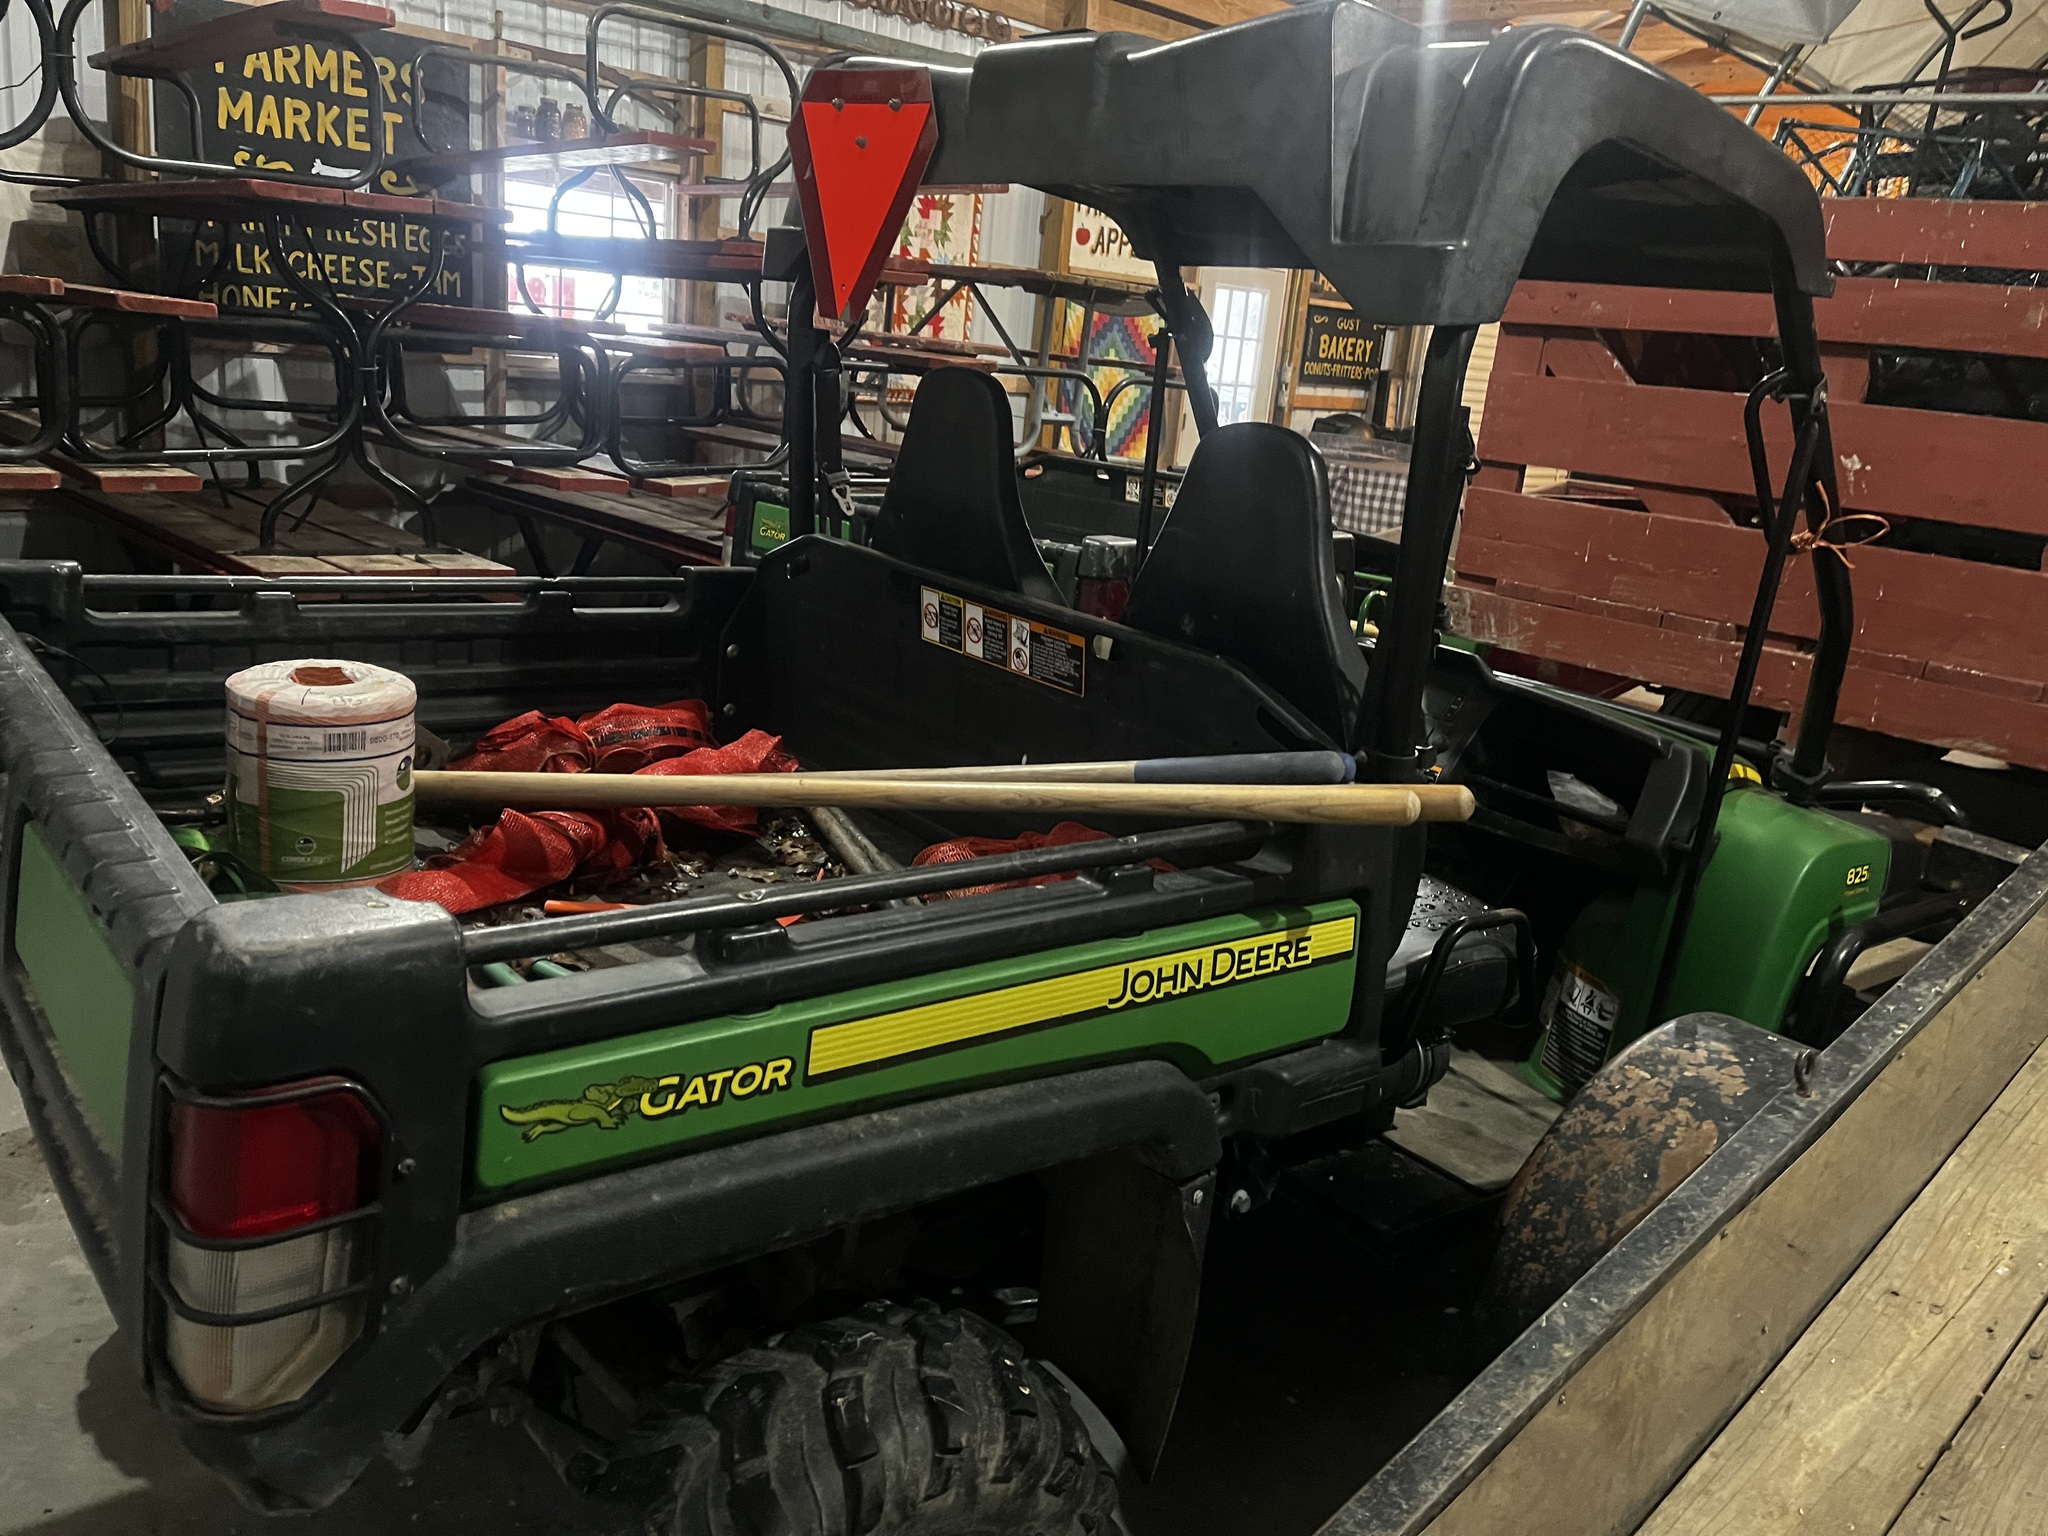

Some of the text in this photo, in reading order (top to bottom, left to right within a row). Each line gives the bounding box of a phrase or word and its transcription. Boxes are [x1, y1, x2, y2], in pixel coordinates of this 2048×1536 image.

[214, 44, 426, 105] ARMERS
[217, 86, 403, 155] MARKET
[306, 219, 397, 249] ESH
[195, 239, 272, 275] MLK
[199, 281, 297, 311] HONE
[1336, 316, 1361, 332] GUST
[1318, 333, 1374, 363] BAKERY
[760, 526, 787, 541] GATOR
[1107, 935, 1313, 1008] JOHN DEERE
[639, 1057, 793, 1117] GATOR
